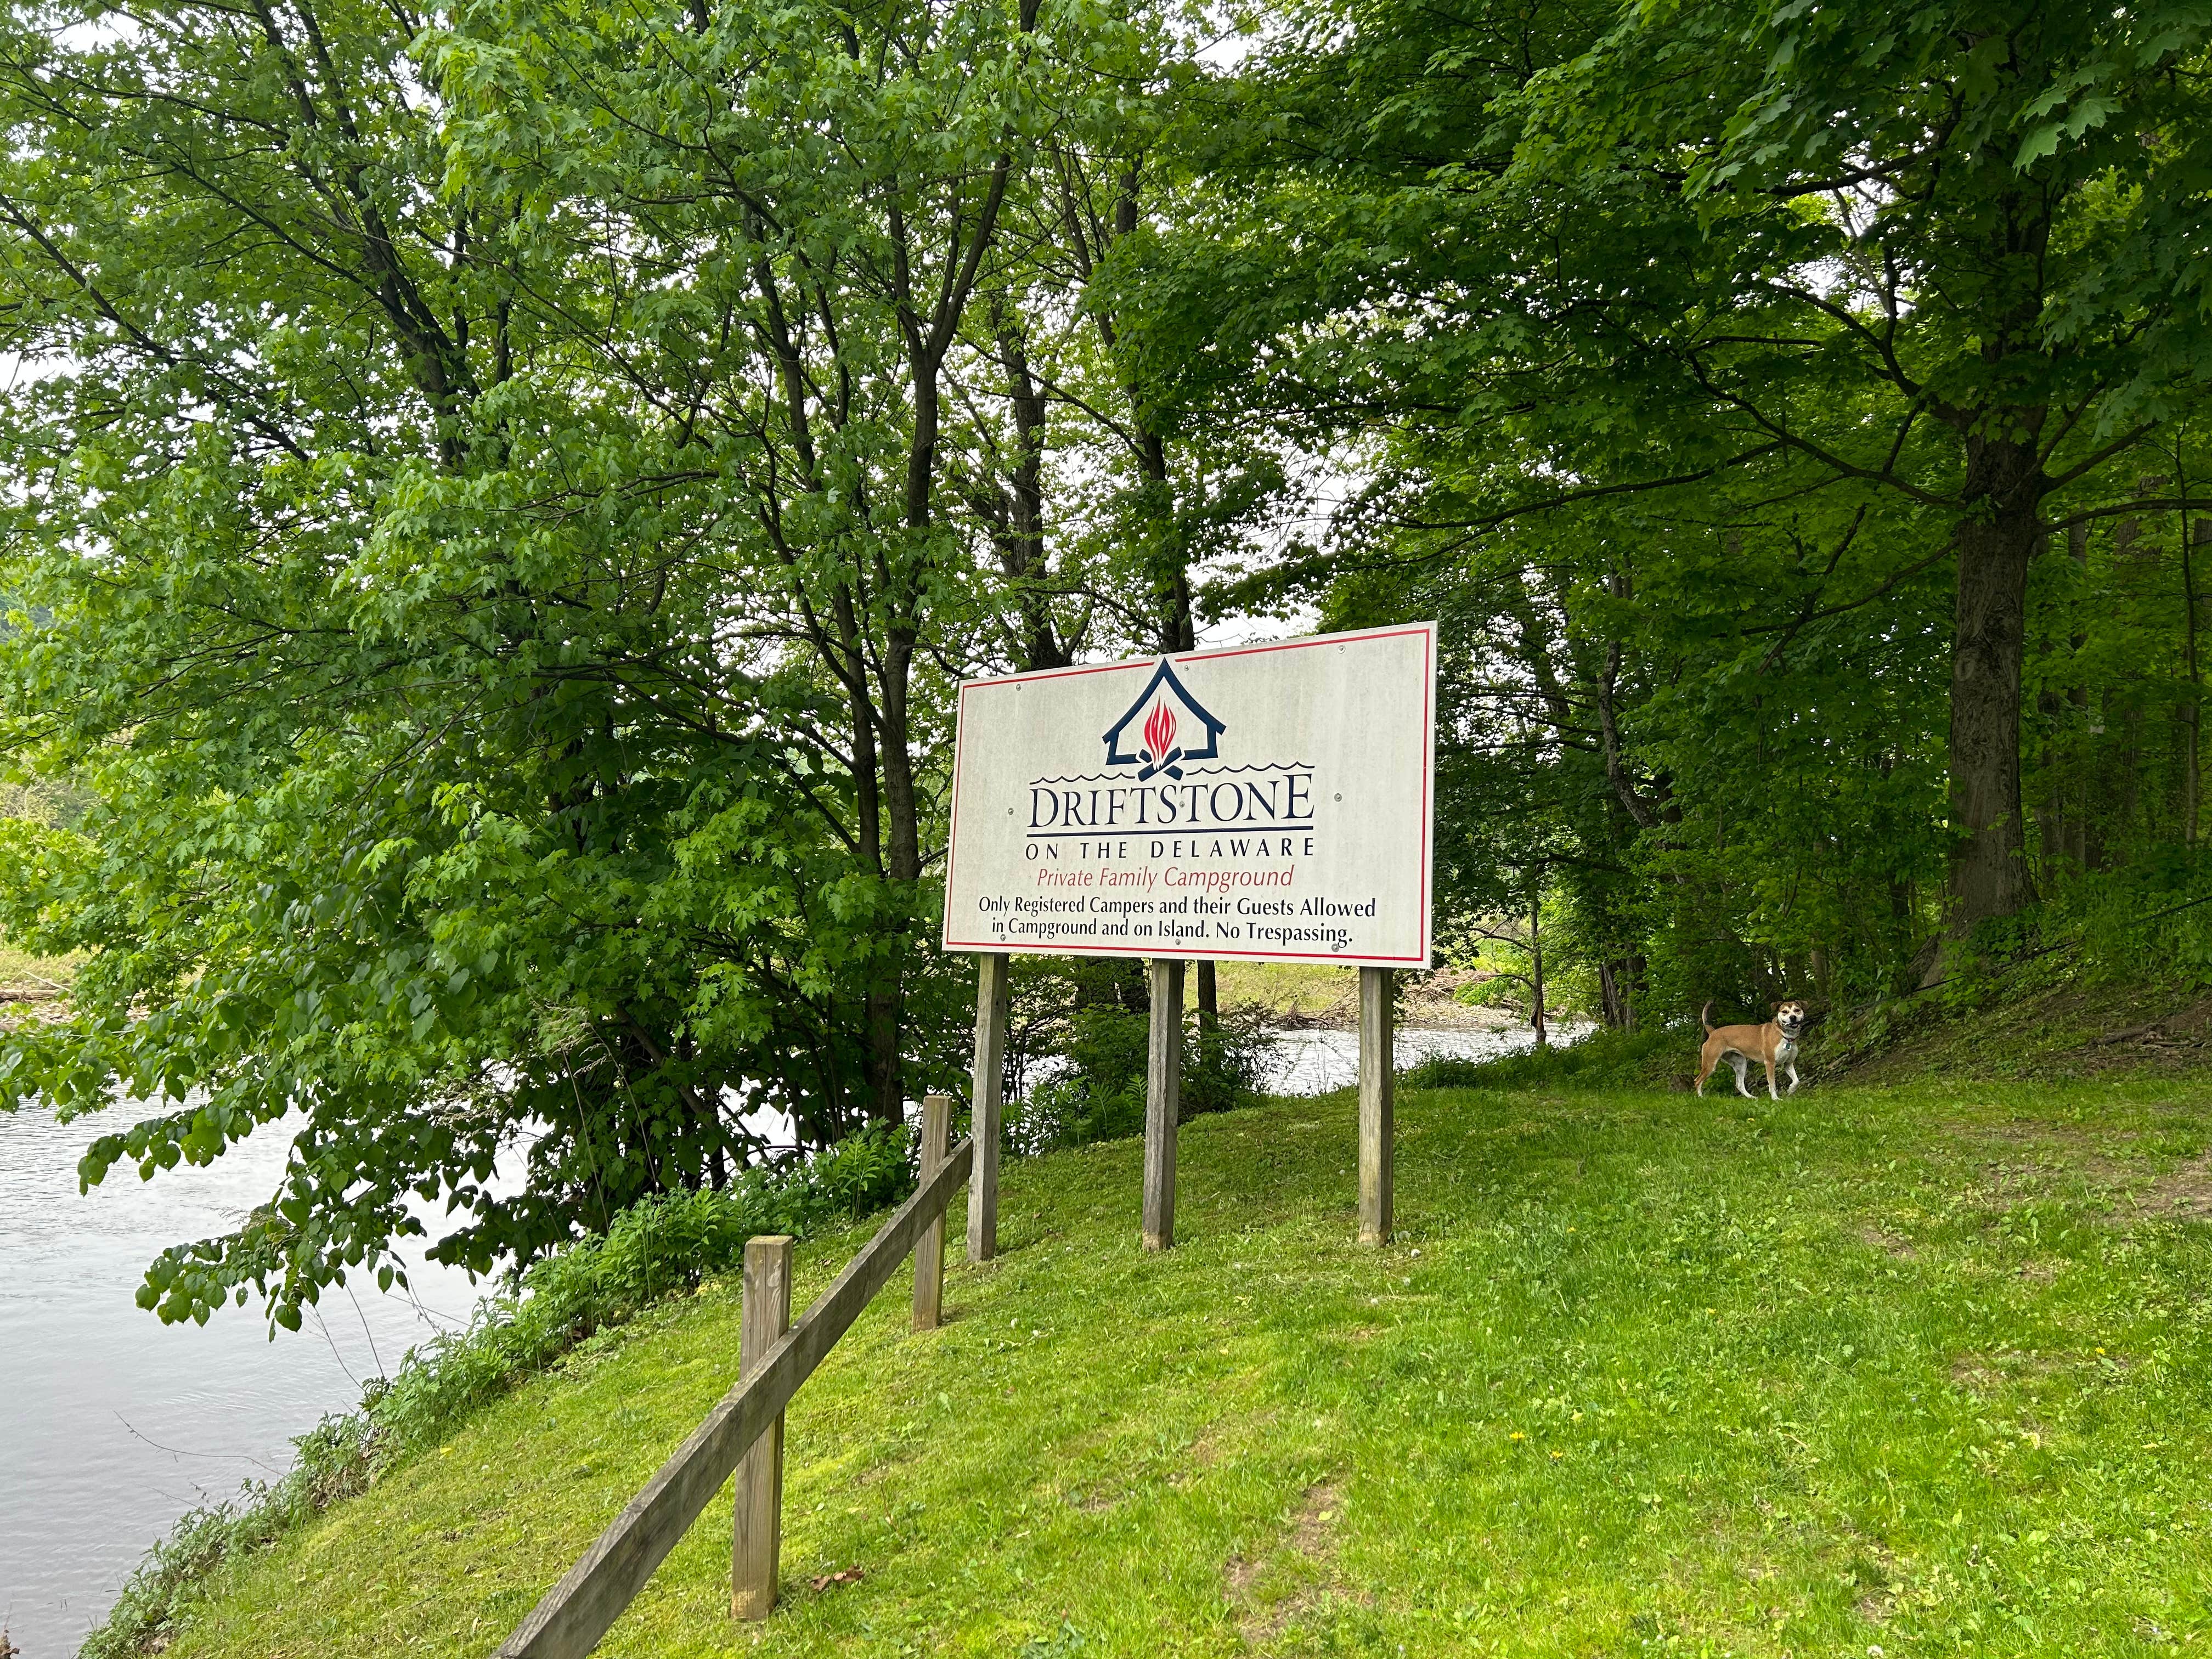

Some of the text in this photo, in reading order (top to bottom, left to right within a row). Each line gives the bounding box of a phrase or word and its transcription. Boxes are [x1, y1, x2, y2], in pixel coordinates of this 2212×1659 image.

[1027, 773, 1315, 828] DRIFTSTONE
[1025, 837, 1314, 860] ON THE DELAWARE
[1037, 864, 1295, 893] Private Family Campground
[979, 895, 1376, 918] Only Registered Campers and their Guests Allowed
[992, 916, 1353, 949] in Campground and on Island. No Trespassing.
